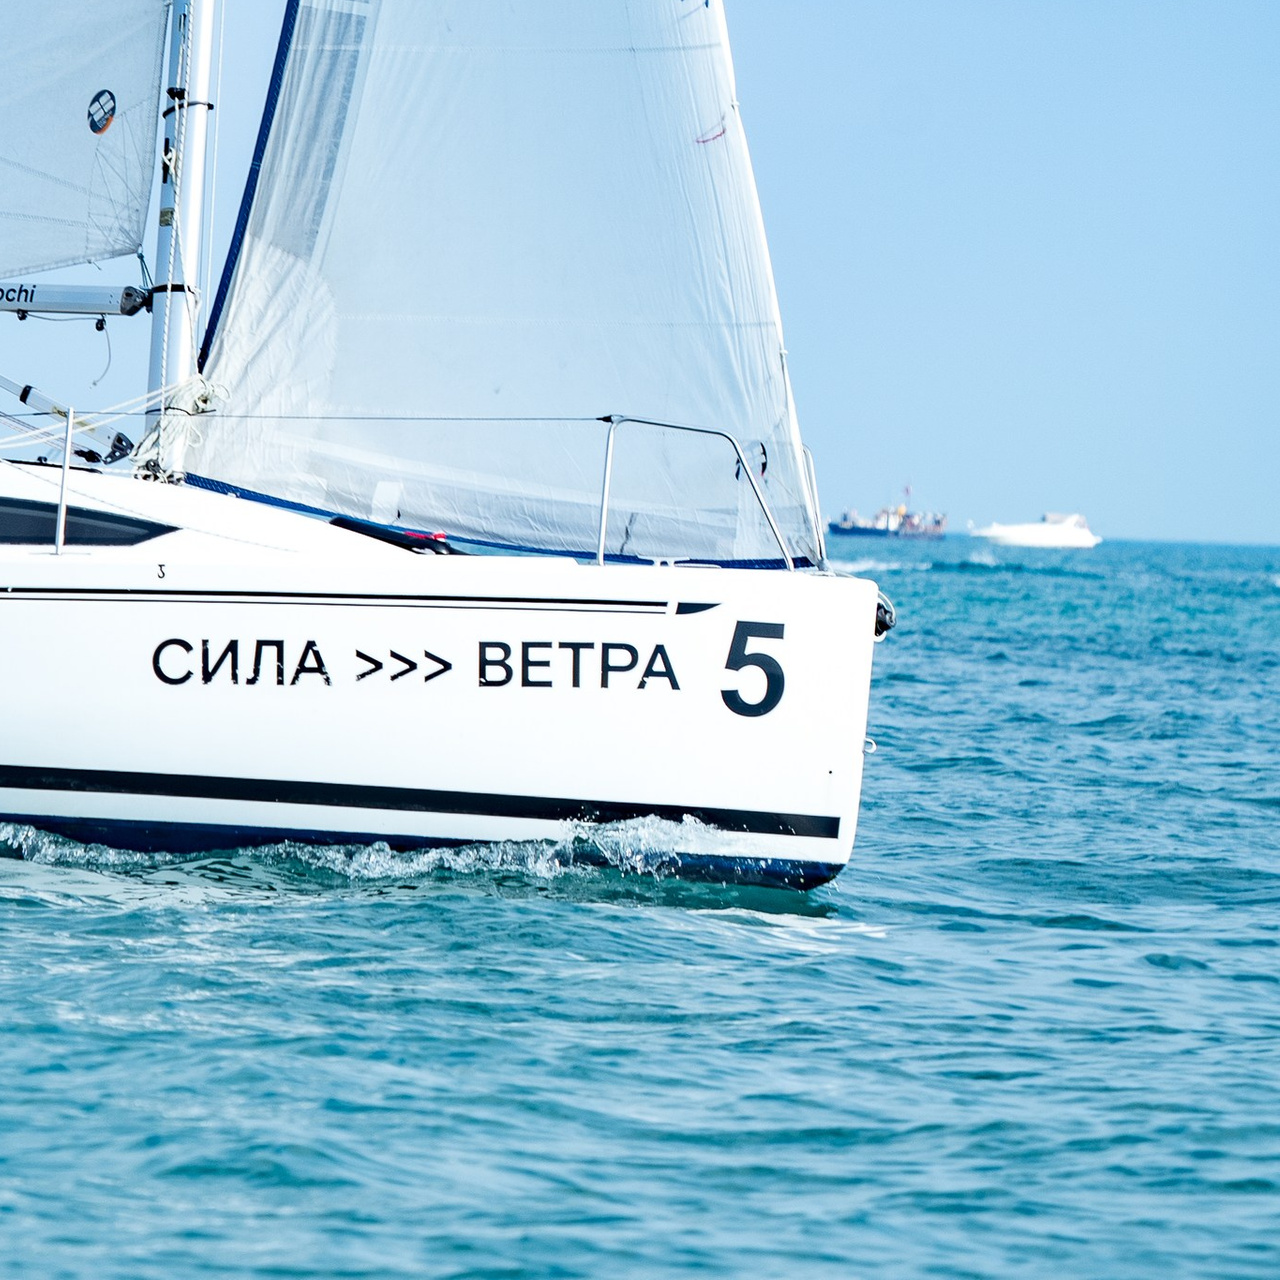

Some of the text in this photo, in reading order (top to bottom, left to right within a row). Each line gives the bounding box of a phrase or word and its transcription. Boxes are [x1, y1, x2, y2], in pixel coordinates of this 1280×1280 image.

[152, 638, 331, 686] СИЛА
[478, 641, 681, 690] ВЕТРА
[720, 620, 785, 718] 5
